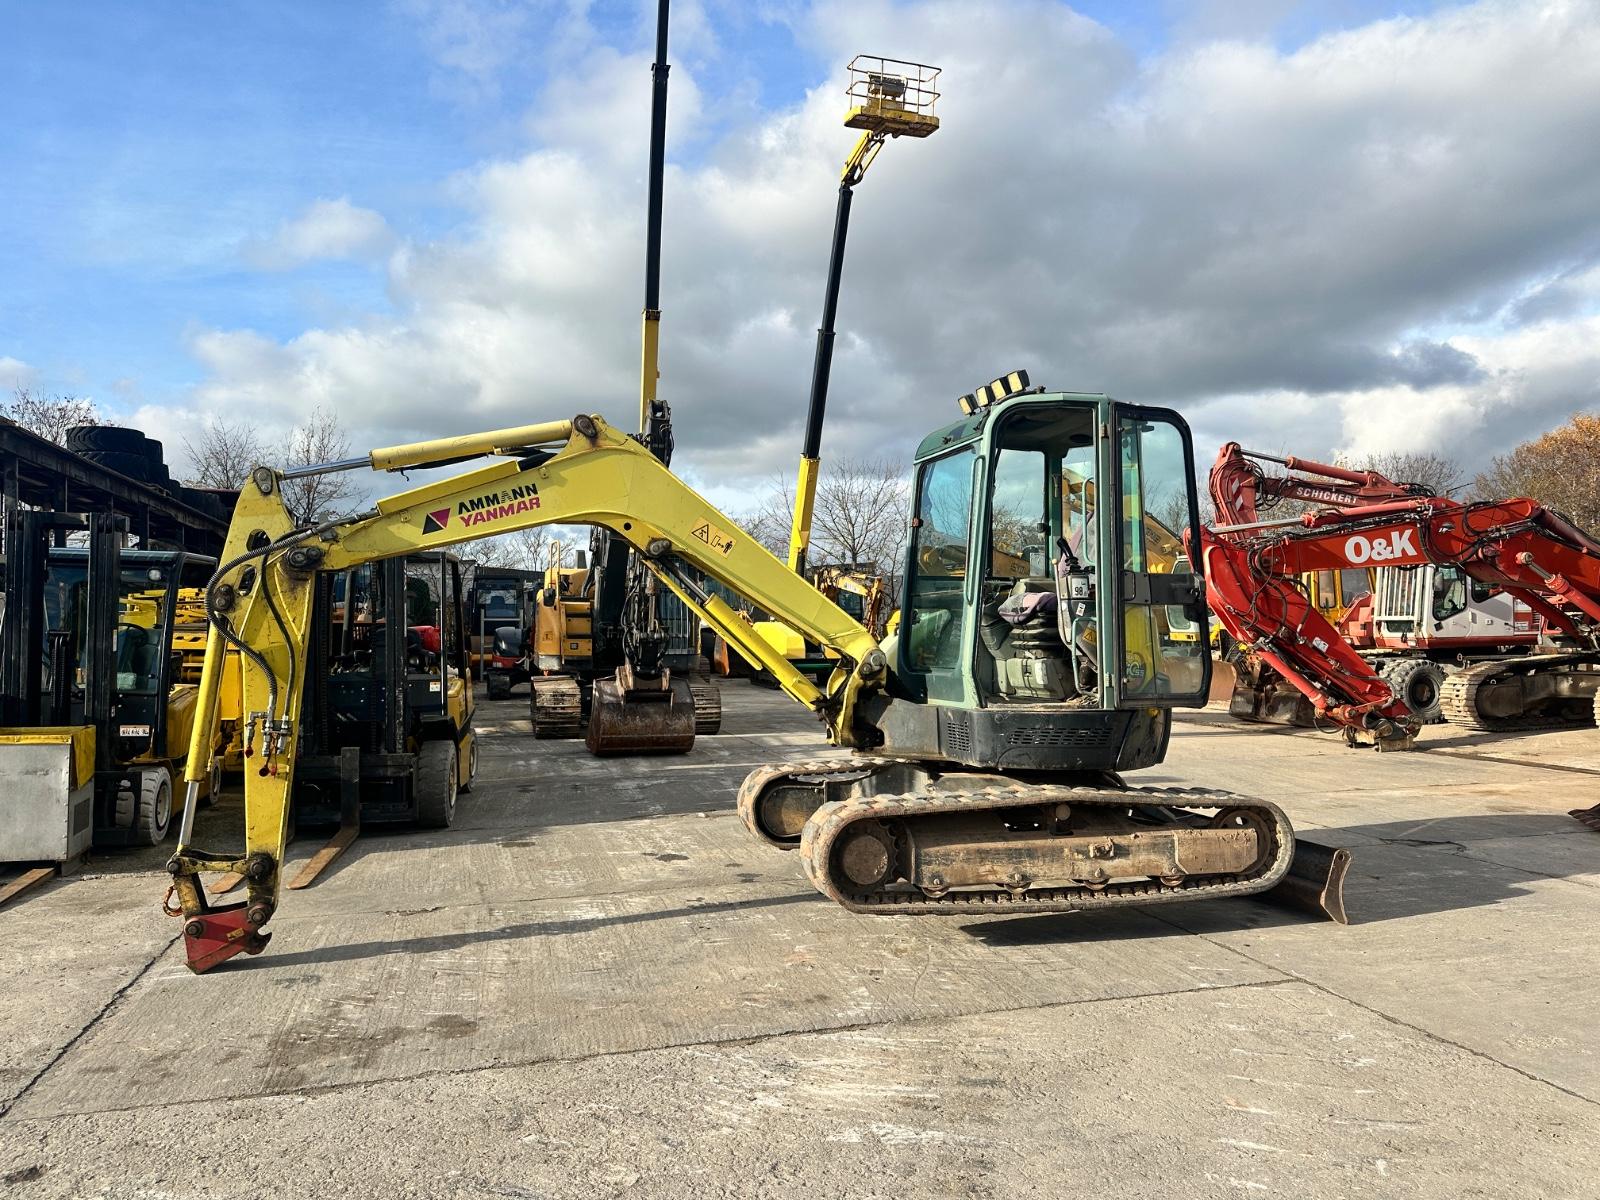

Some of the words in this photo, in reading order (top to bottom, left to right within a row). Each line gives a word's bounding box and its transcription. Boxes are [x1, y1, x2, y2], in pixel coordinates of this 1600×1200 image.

[458, 483, 538, 515] AMMANN
[1297, 487, 1358, 504] SCHICKERT
[459, 497, 541, 527] YANMAR
[1344, 529, 1417, 563] O&K
[1075, 587, 1084, 596] 98
